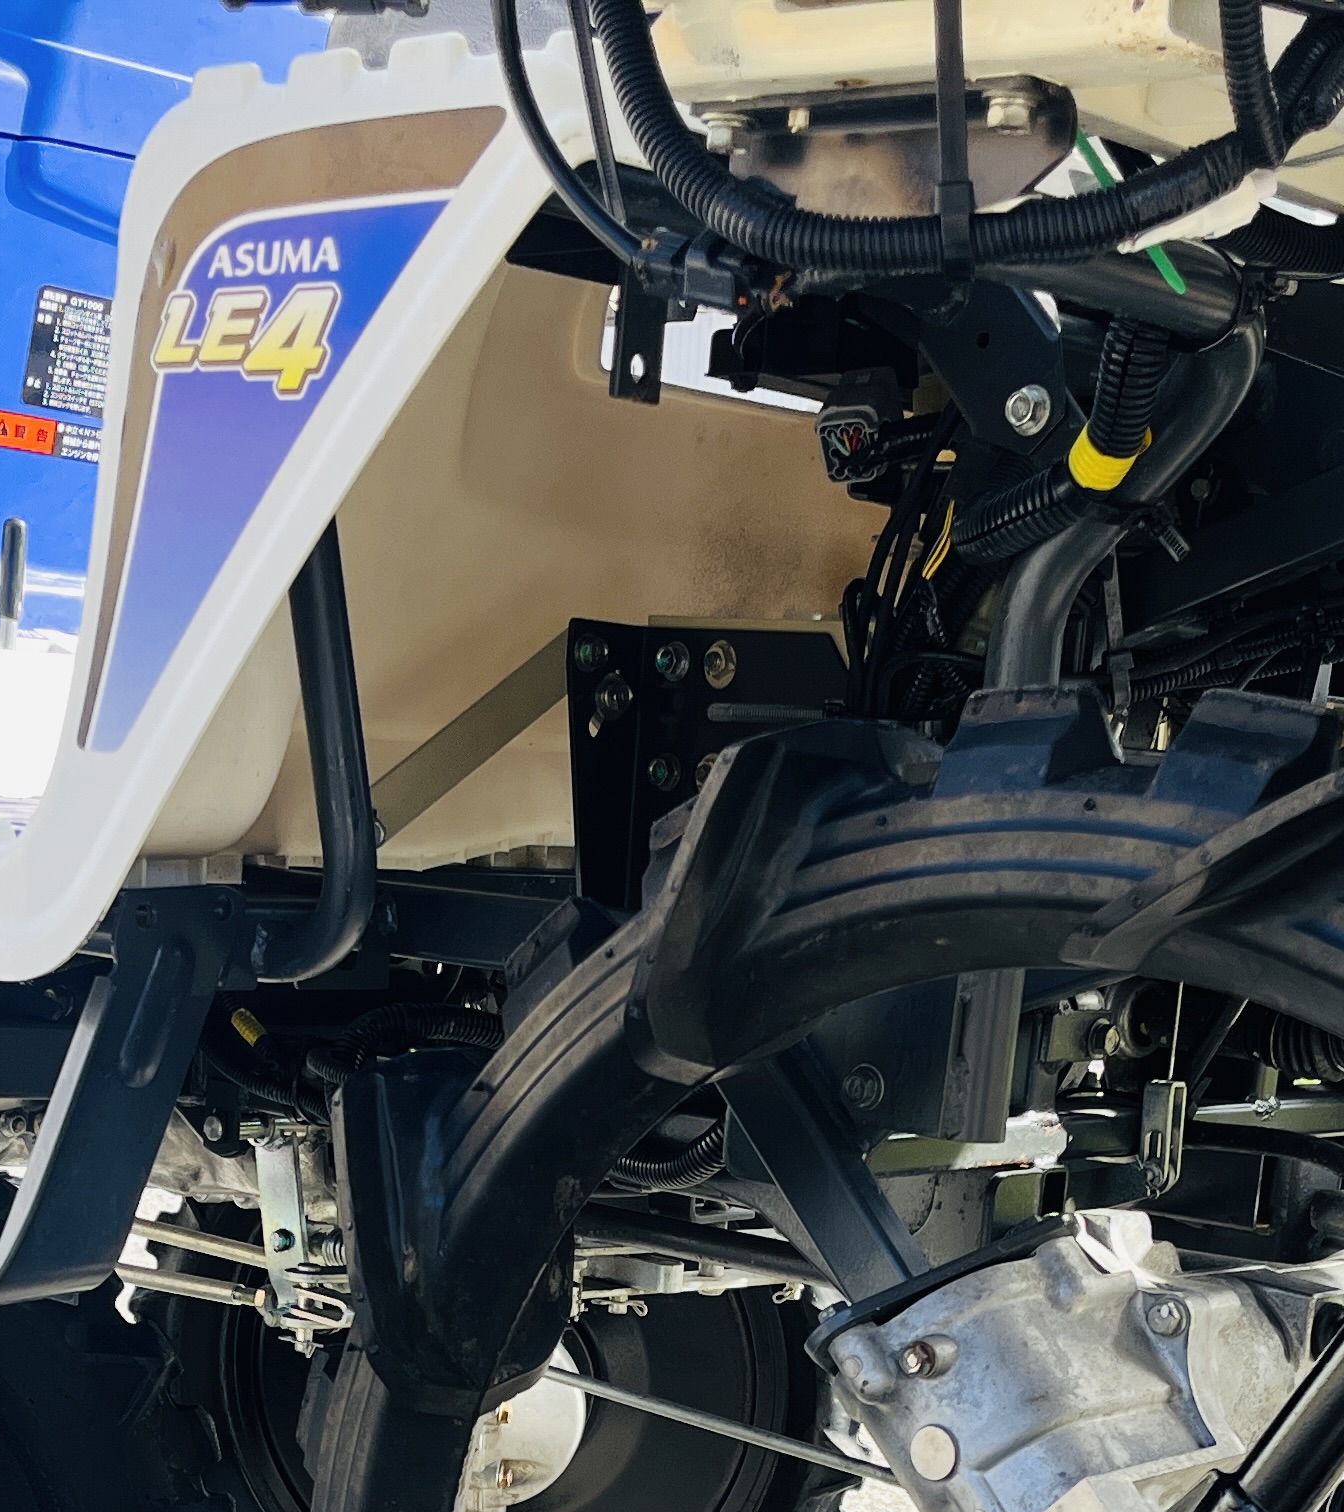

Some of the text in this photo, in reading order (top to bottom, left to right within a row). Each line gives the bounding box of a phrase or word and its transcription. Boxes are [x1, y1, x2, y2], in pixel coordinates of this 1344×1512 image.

[207, 236, 341, 280] ASUMA
[70, 296, 104, 312] GT1000
[152, 283, 340, 399] LE4
[14, 424, 49, 443] 警告
